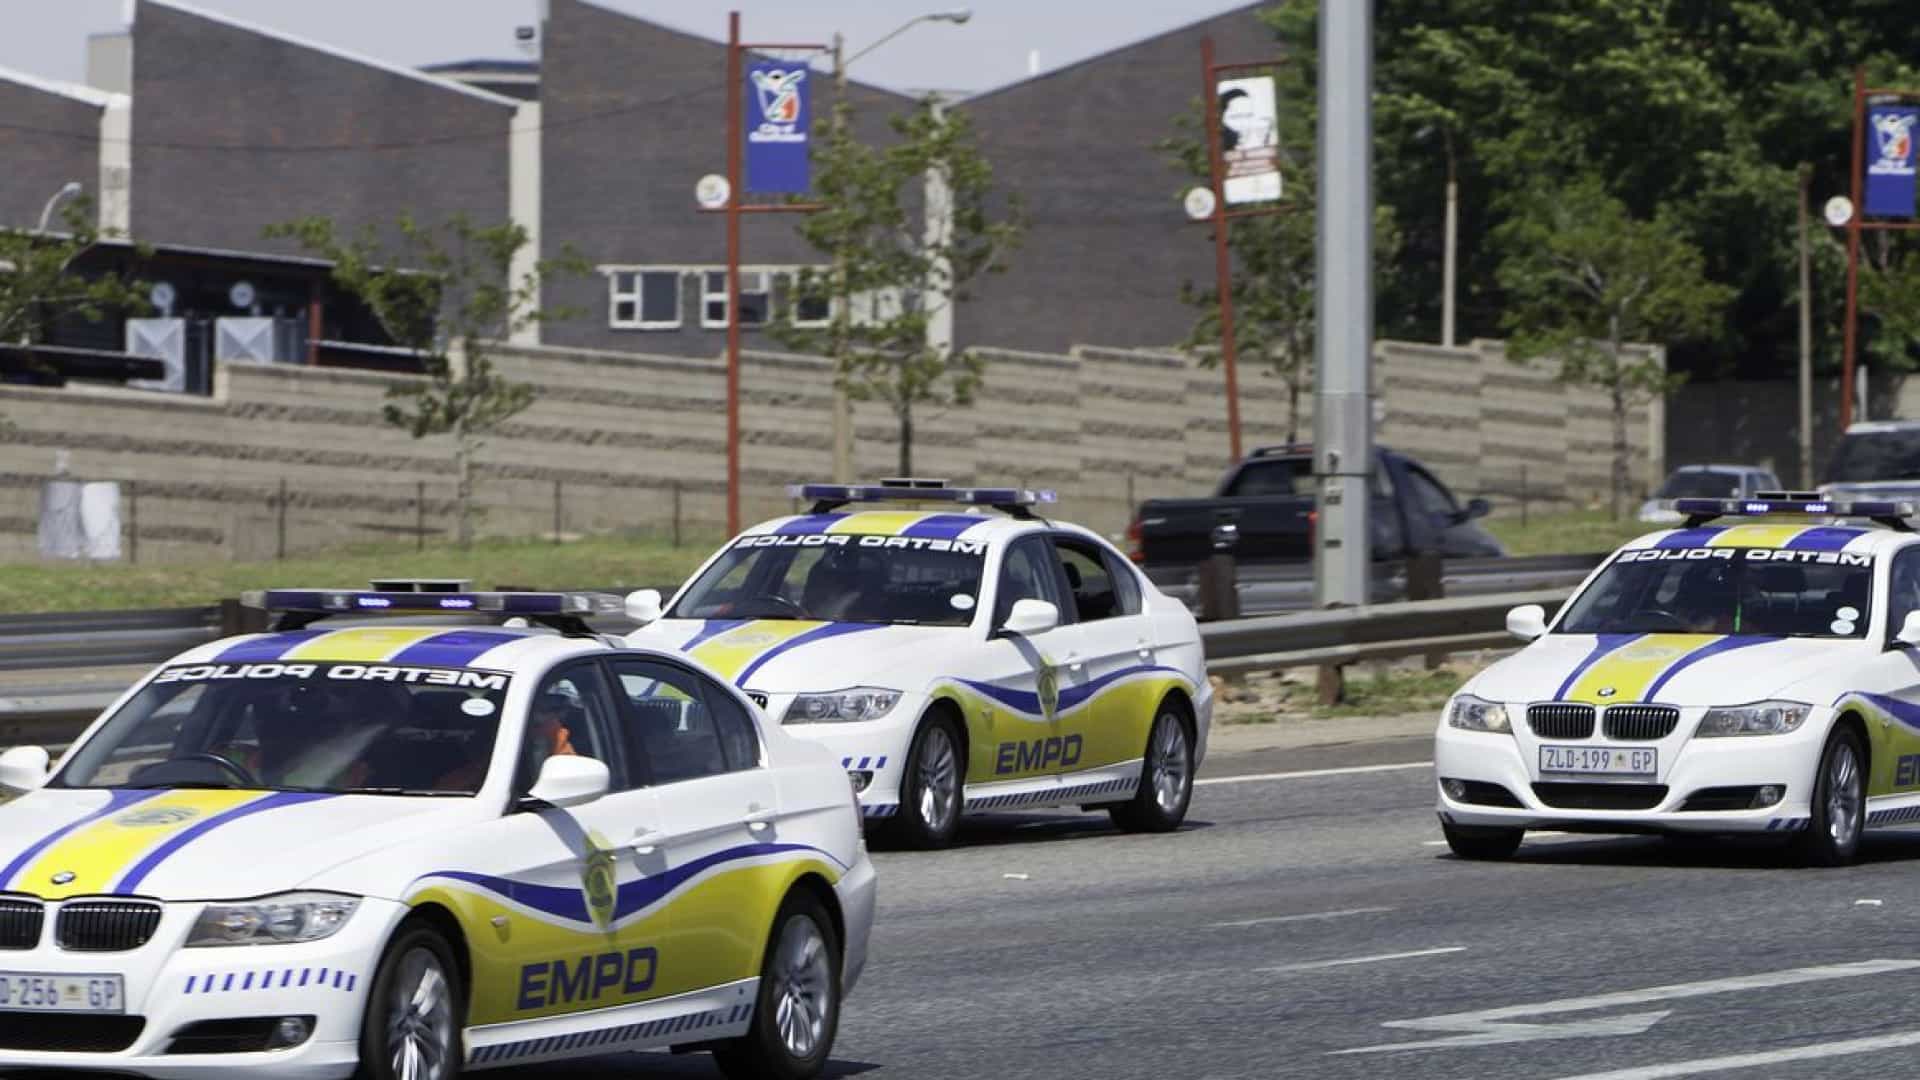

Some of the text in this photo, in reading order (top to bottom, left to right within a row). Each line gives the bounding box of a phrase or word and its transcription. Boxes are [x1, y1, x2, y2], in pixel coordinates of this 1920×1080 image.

[995, 734, 1083, 774] EMPD
[1546, 749, 1652, 770] ZLD-199 GP
[88, 980, 115, 1006] GP
[517, 947, 659, 1010] EMPD
